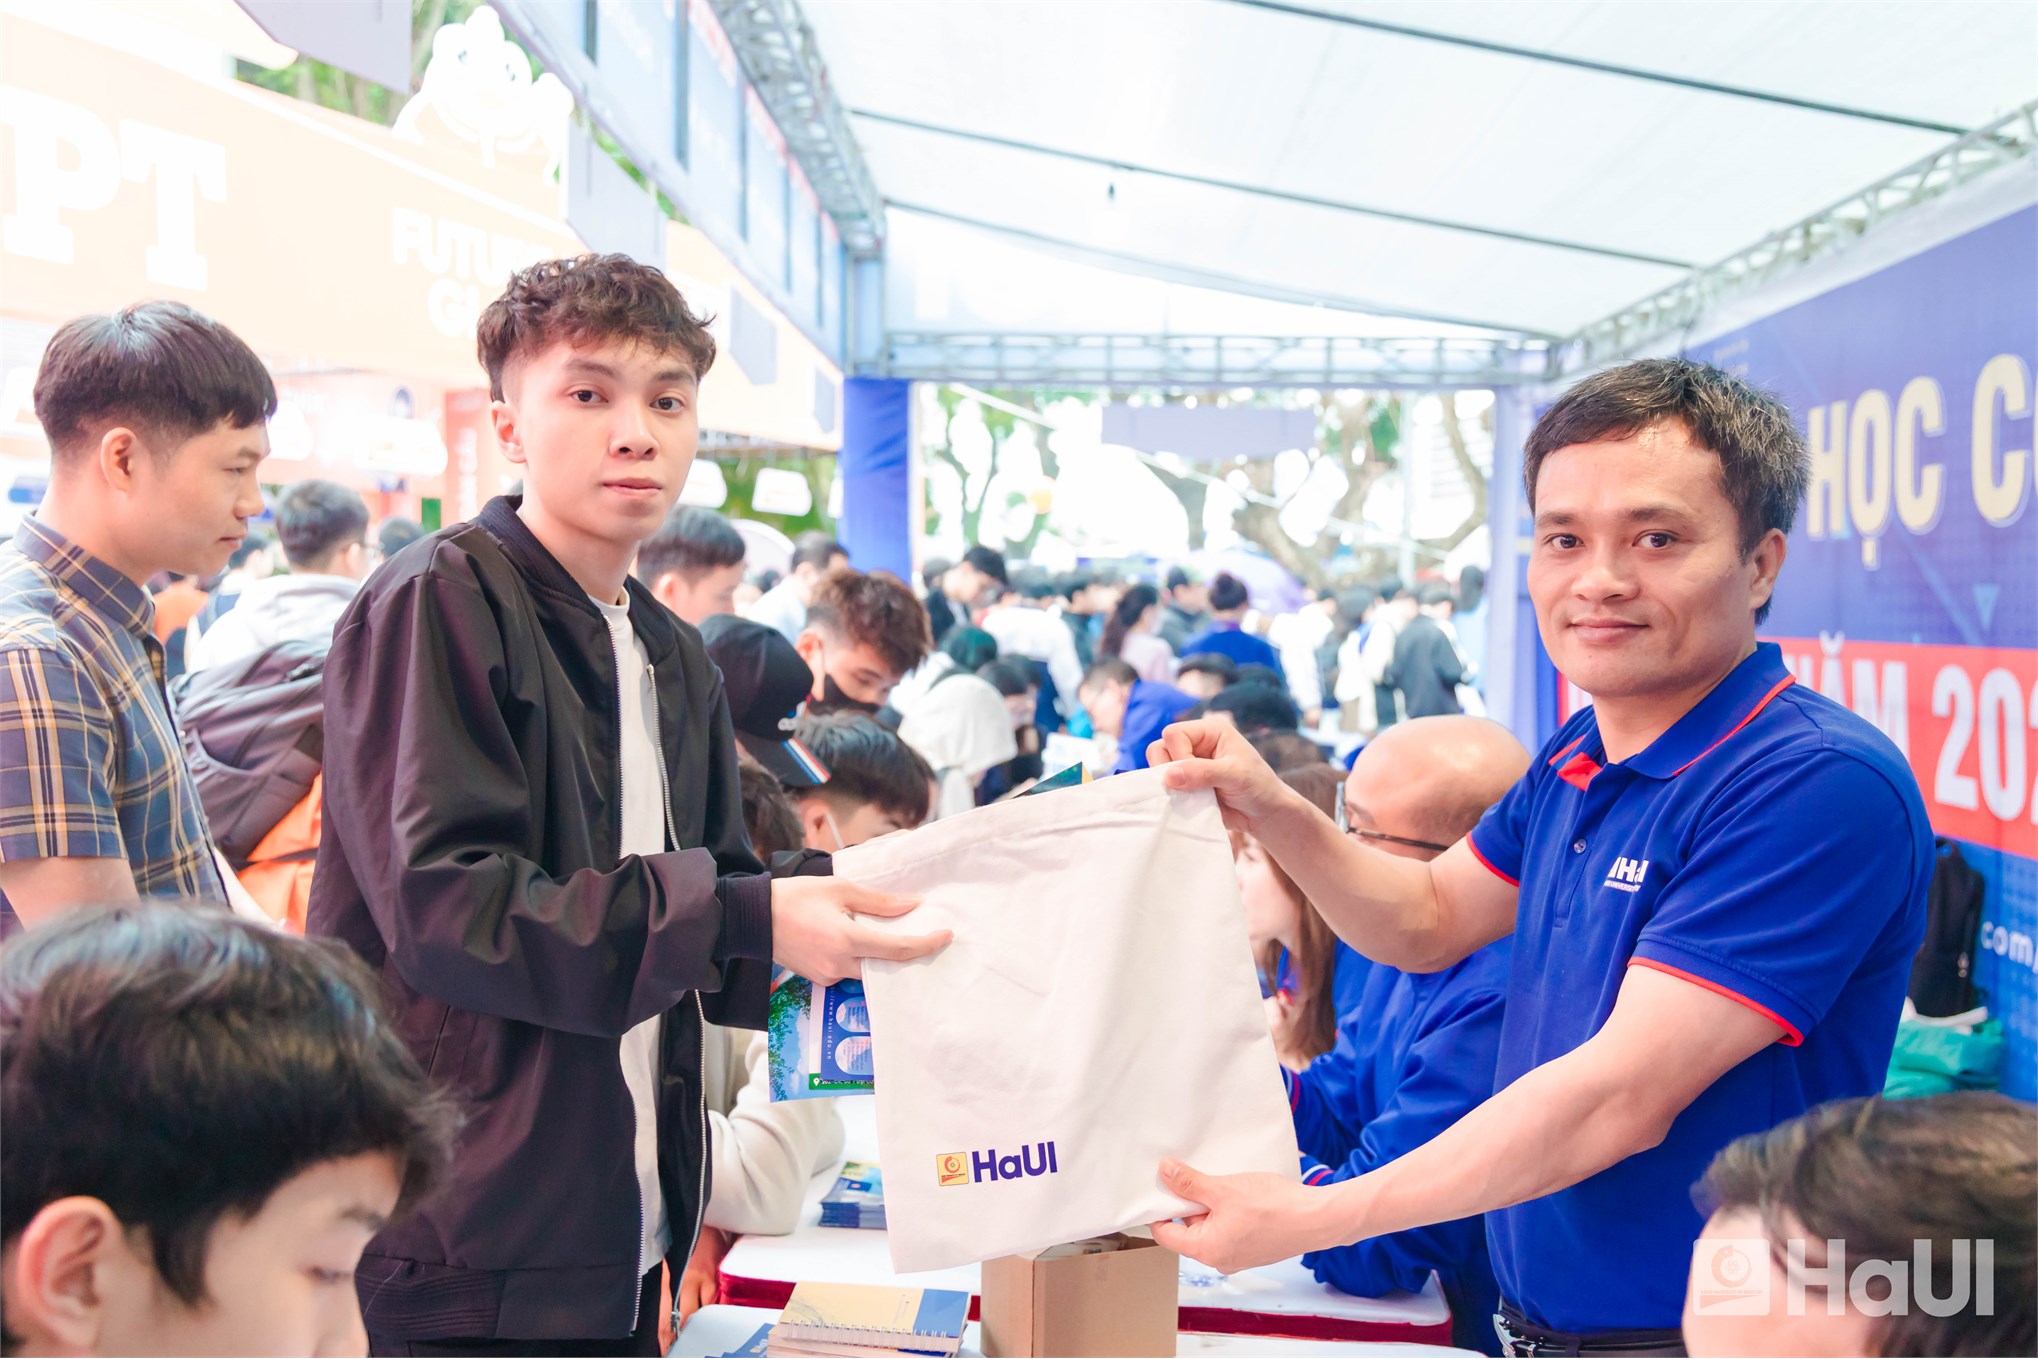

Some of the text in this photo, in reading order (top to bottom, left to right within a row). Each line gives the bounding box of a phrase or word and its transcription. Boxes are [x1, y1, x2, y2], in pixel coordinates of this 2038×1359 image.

[1806, 353, 2038, 571] HỌC C
[971, 1141, 1058, 1183] HaUI
